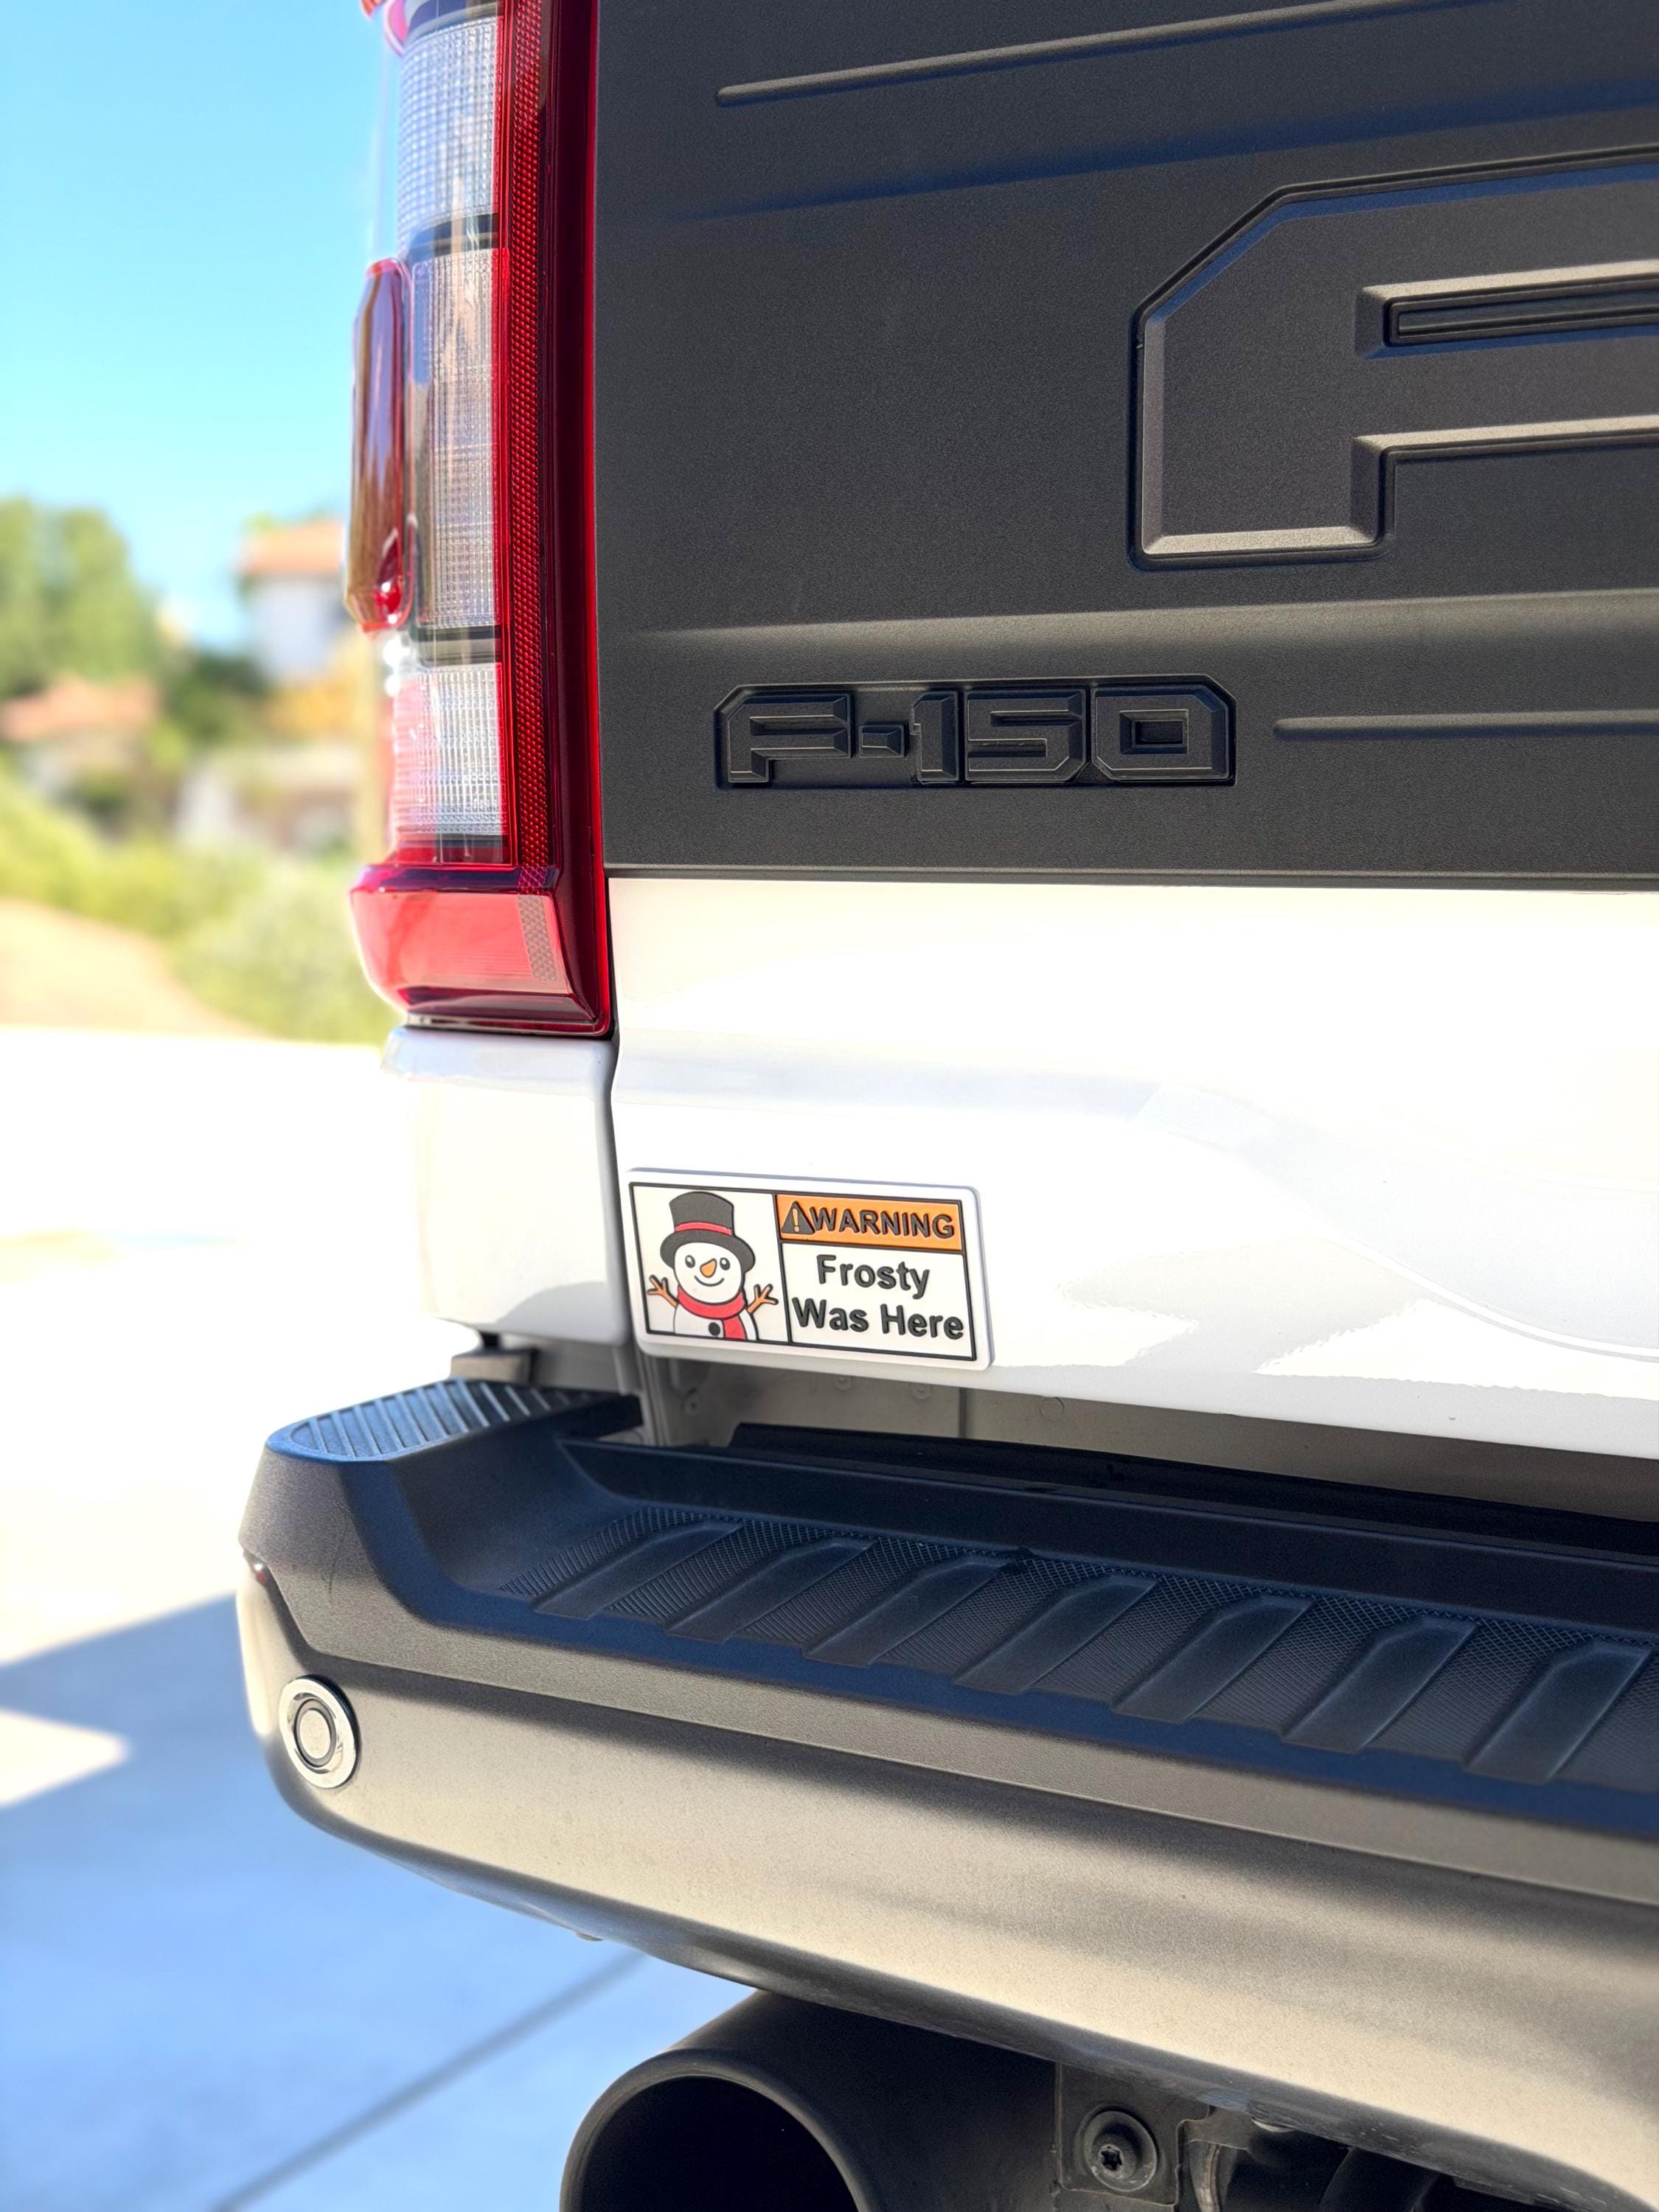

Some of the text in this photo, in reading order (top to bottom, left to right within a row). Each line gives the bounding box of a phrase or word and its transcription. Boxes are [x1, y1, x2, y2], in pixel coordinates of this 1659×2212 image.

[726, 684, 1232, 786] F-150
[809, 1206, 954, 1239] WARNING
[815, 1253, 931, 1300] Frosty
[791, 1296, 964, 1340] Was Here
